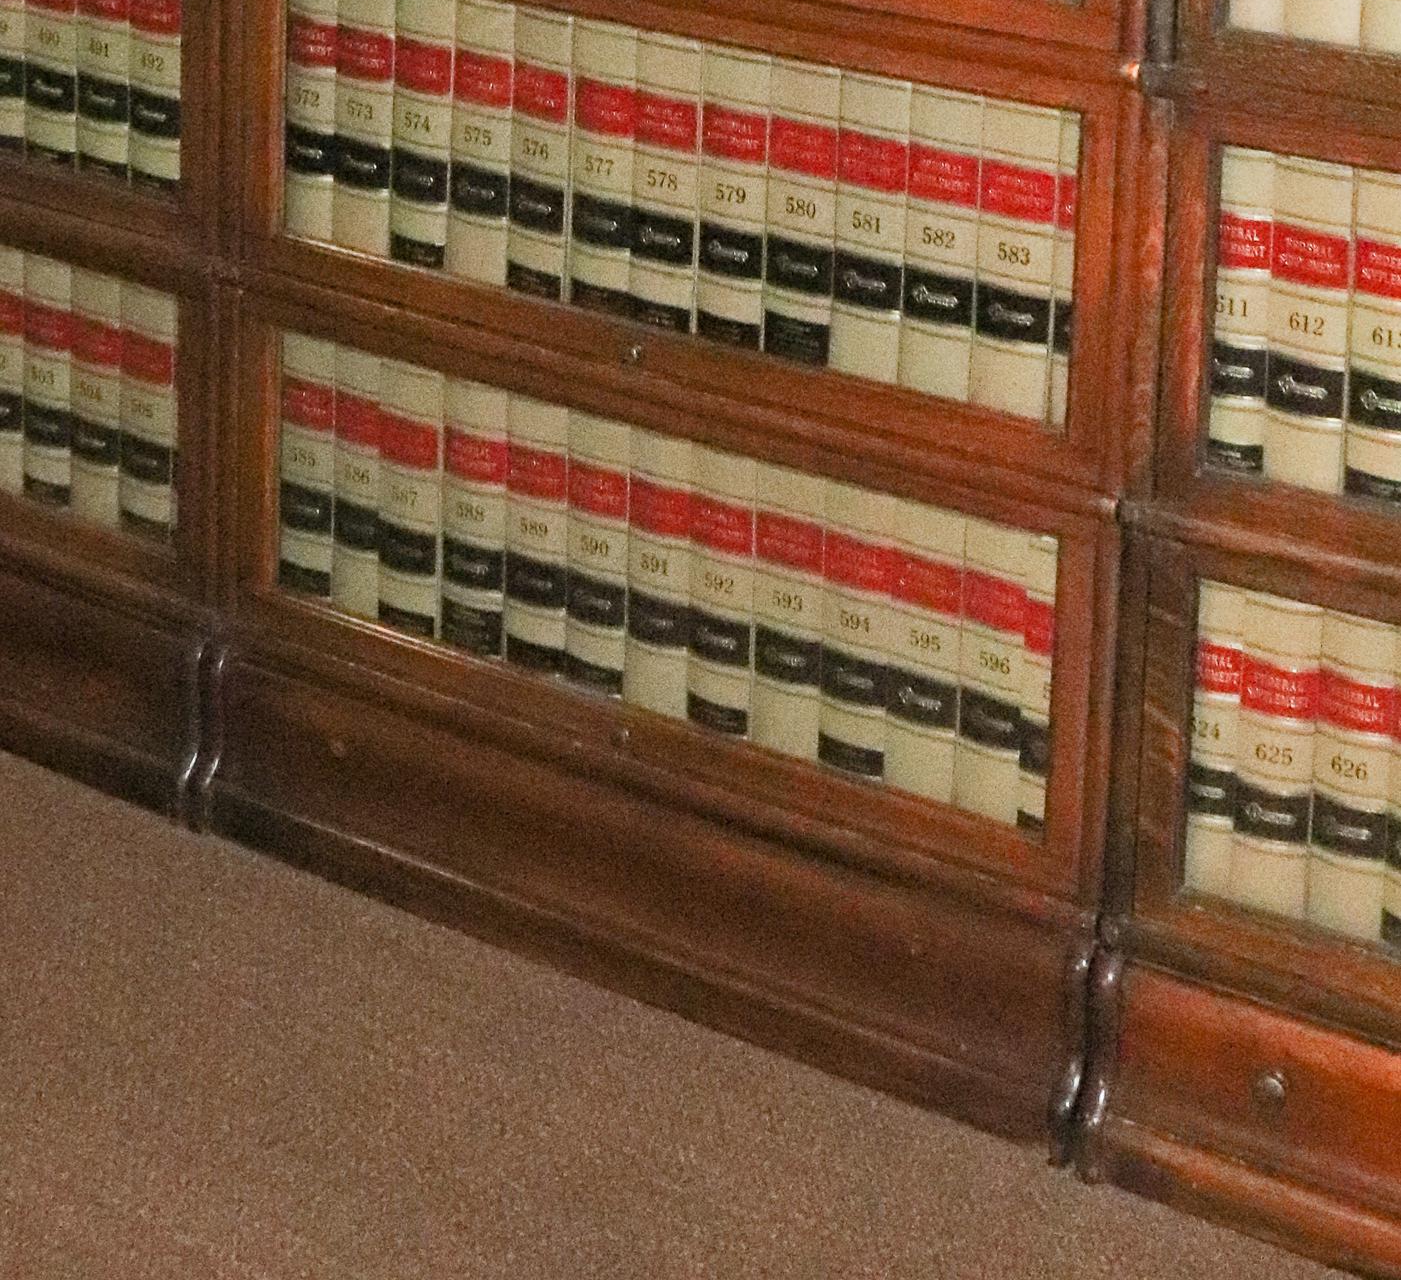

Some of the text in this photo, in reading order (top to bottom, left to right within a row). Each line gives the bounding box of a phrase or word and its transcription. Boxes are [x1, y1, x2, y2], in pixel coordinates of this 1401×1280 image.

[348, 99, 373, 119] 573
[405, 112, 431, 133] 574
[464, 126, 491, 146] 575
[585, 157, 614, 175] 577
[647, 170, 677, 189] 578
[716, 183, 745, 202] 579
[786, 197, 815, 218] 580
[852, 213, 880, 234] 581
[922, 228, 954, 248] 582
[998, 243, 1030, 265] 583
[1216, 296, 1247, 316] 611
[1289, 313, 1325, 336] 612
[704, 574, 734, 594] 592
[772, 591, 803, 612] 593
[910, 630, 940, 650] 595
[979, 651, 1010, 674] 596
[1256, 744, 1292, 766] 625
[1331, 756, 1367, 781] 626
